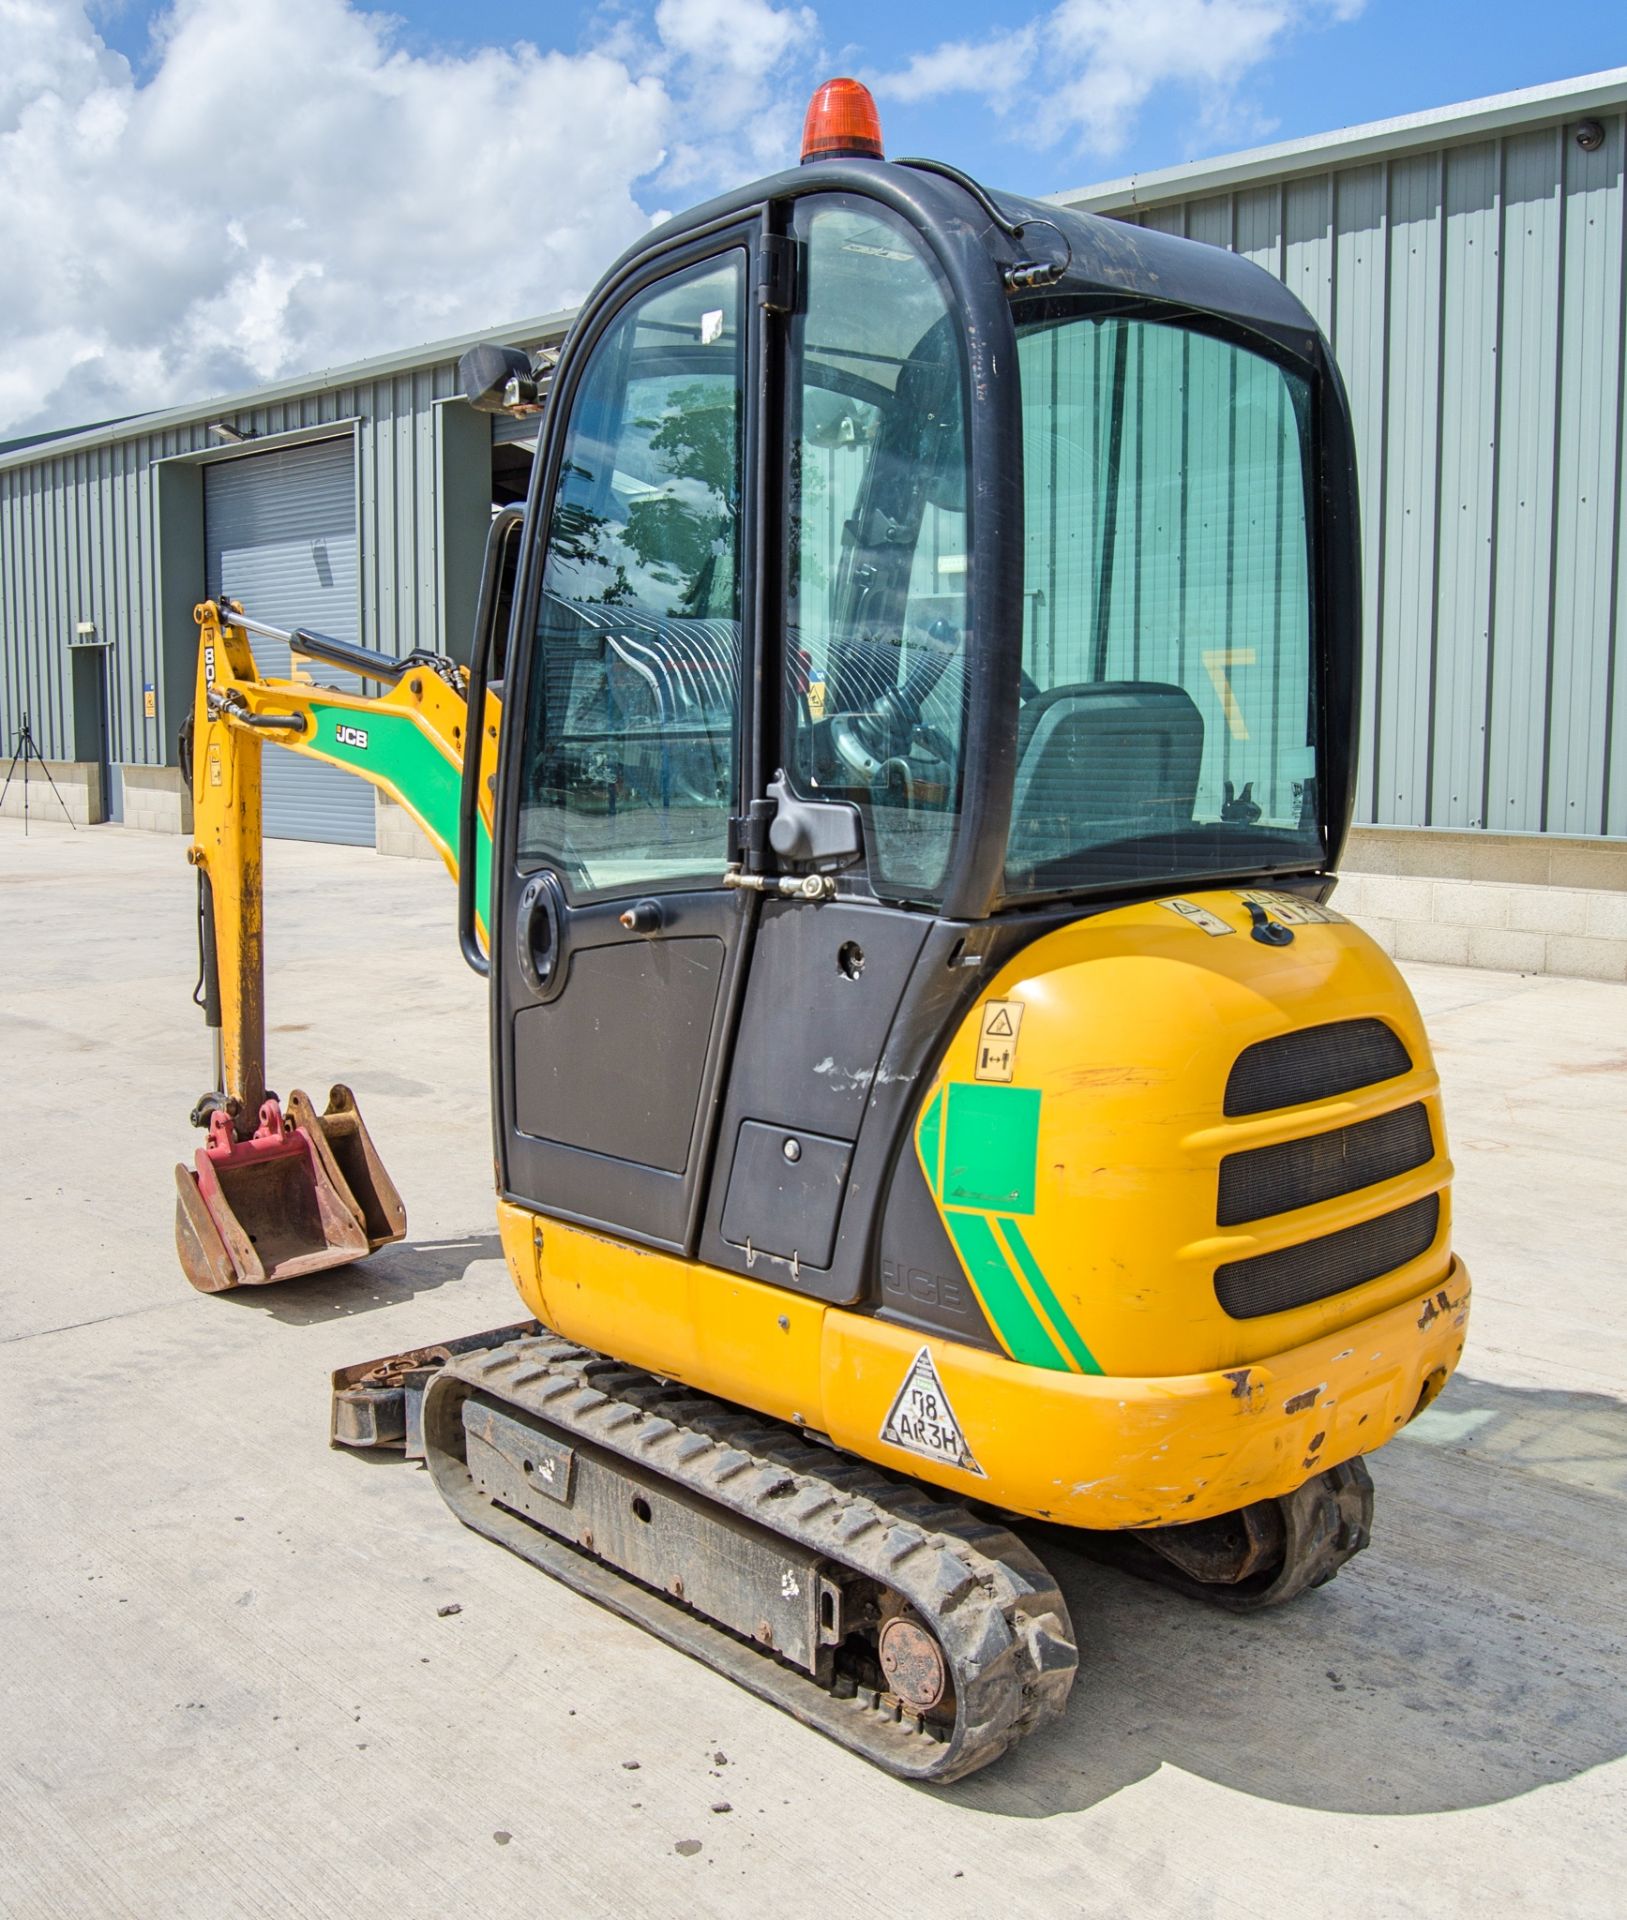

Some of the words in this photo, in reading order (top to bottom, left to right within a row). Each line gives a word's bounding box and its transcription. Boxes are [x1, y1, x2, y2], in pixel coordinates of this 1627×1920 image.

[336, 725, 368, 749] JCB
[883, 1260, 968, 1314] JCB
[901, 1414, 957, 1455] AR3H
